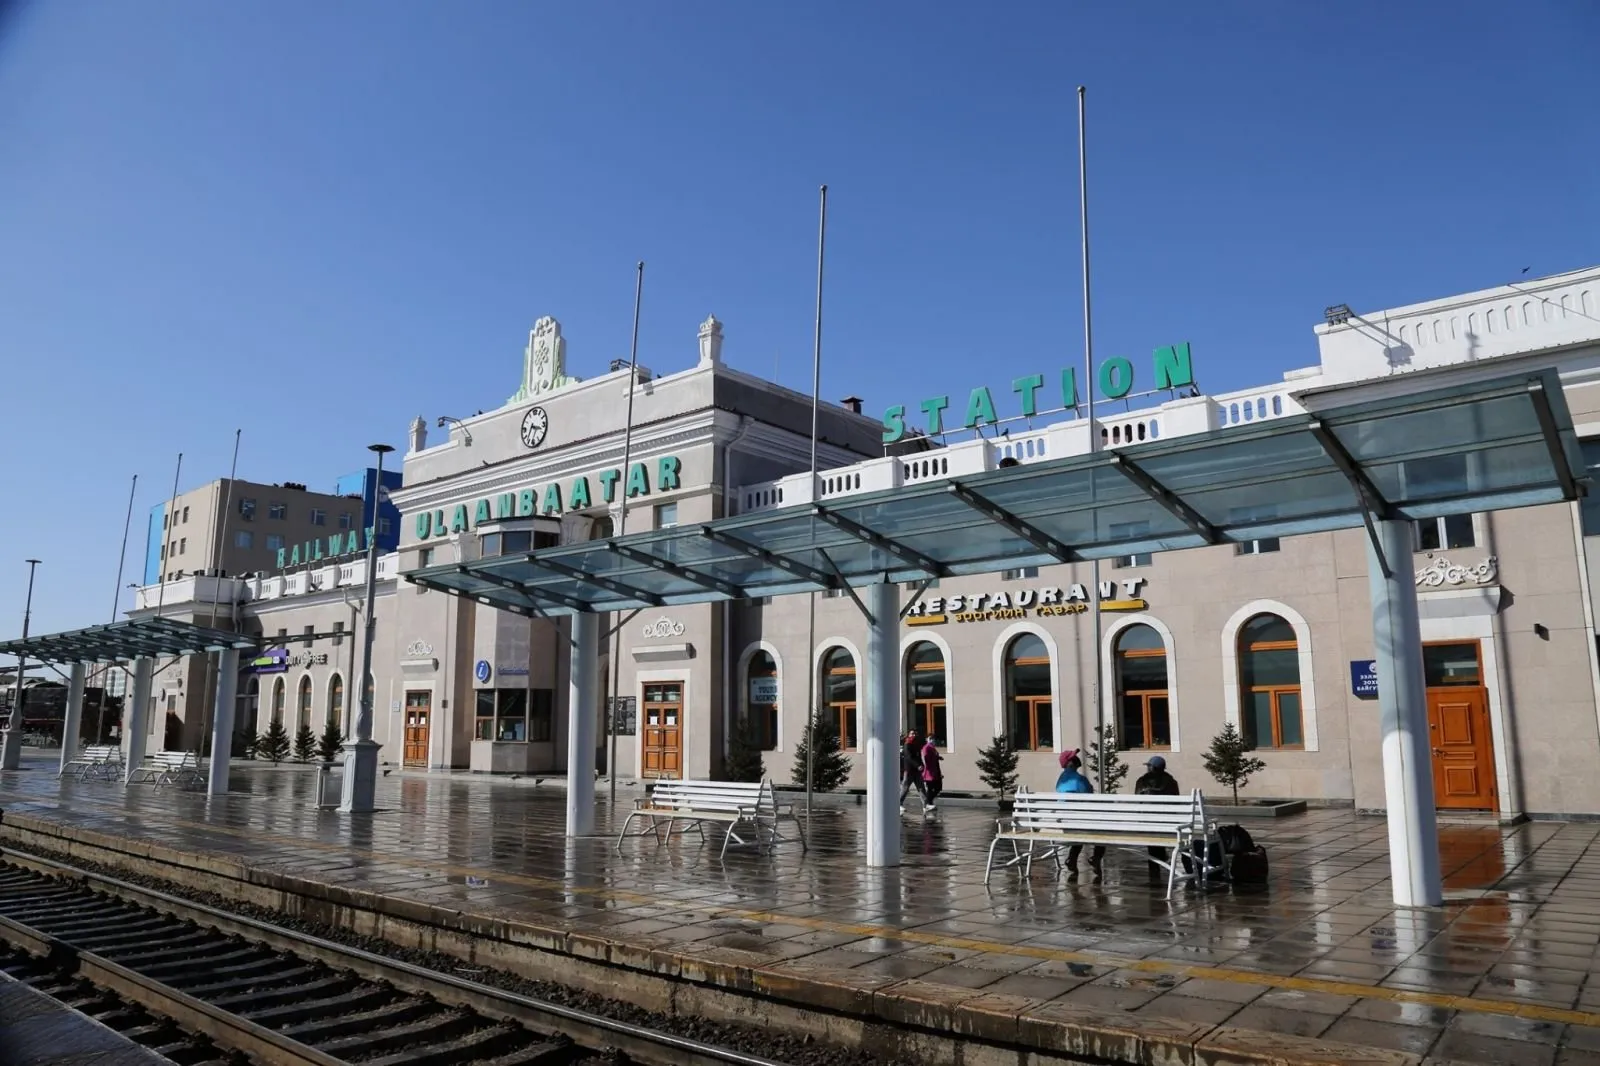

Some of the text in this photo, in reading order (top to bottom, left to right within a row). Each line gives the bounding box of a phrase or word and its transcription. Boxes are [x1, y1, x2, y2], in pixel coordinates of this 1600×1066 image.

[882, 341, 1194, 443] STATION
[415, 456, 681, 540] ULAANBAATAR
[277, 526, 374, 569] RAILWAY
[907, 577, 1147, 618] RESTAURANT
[309, 653, 328, 666] FREE
